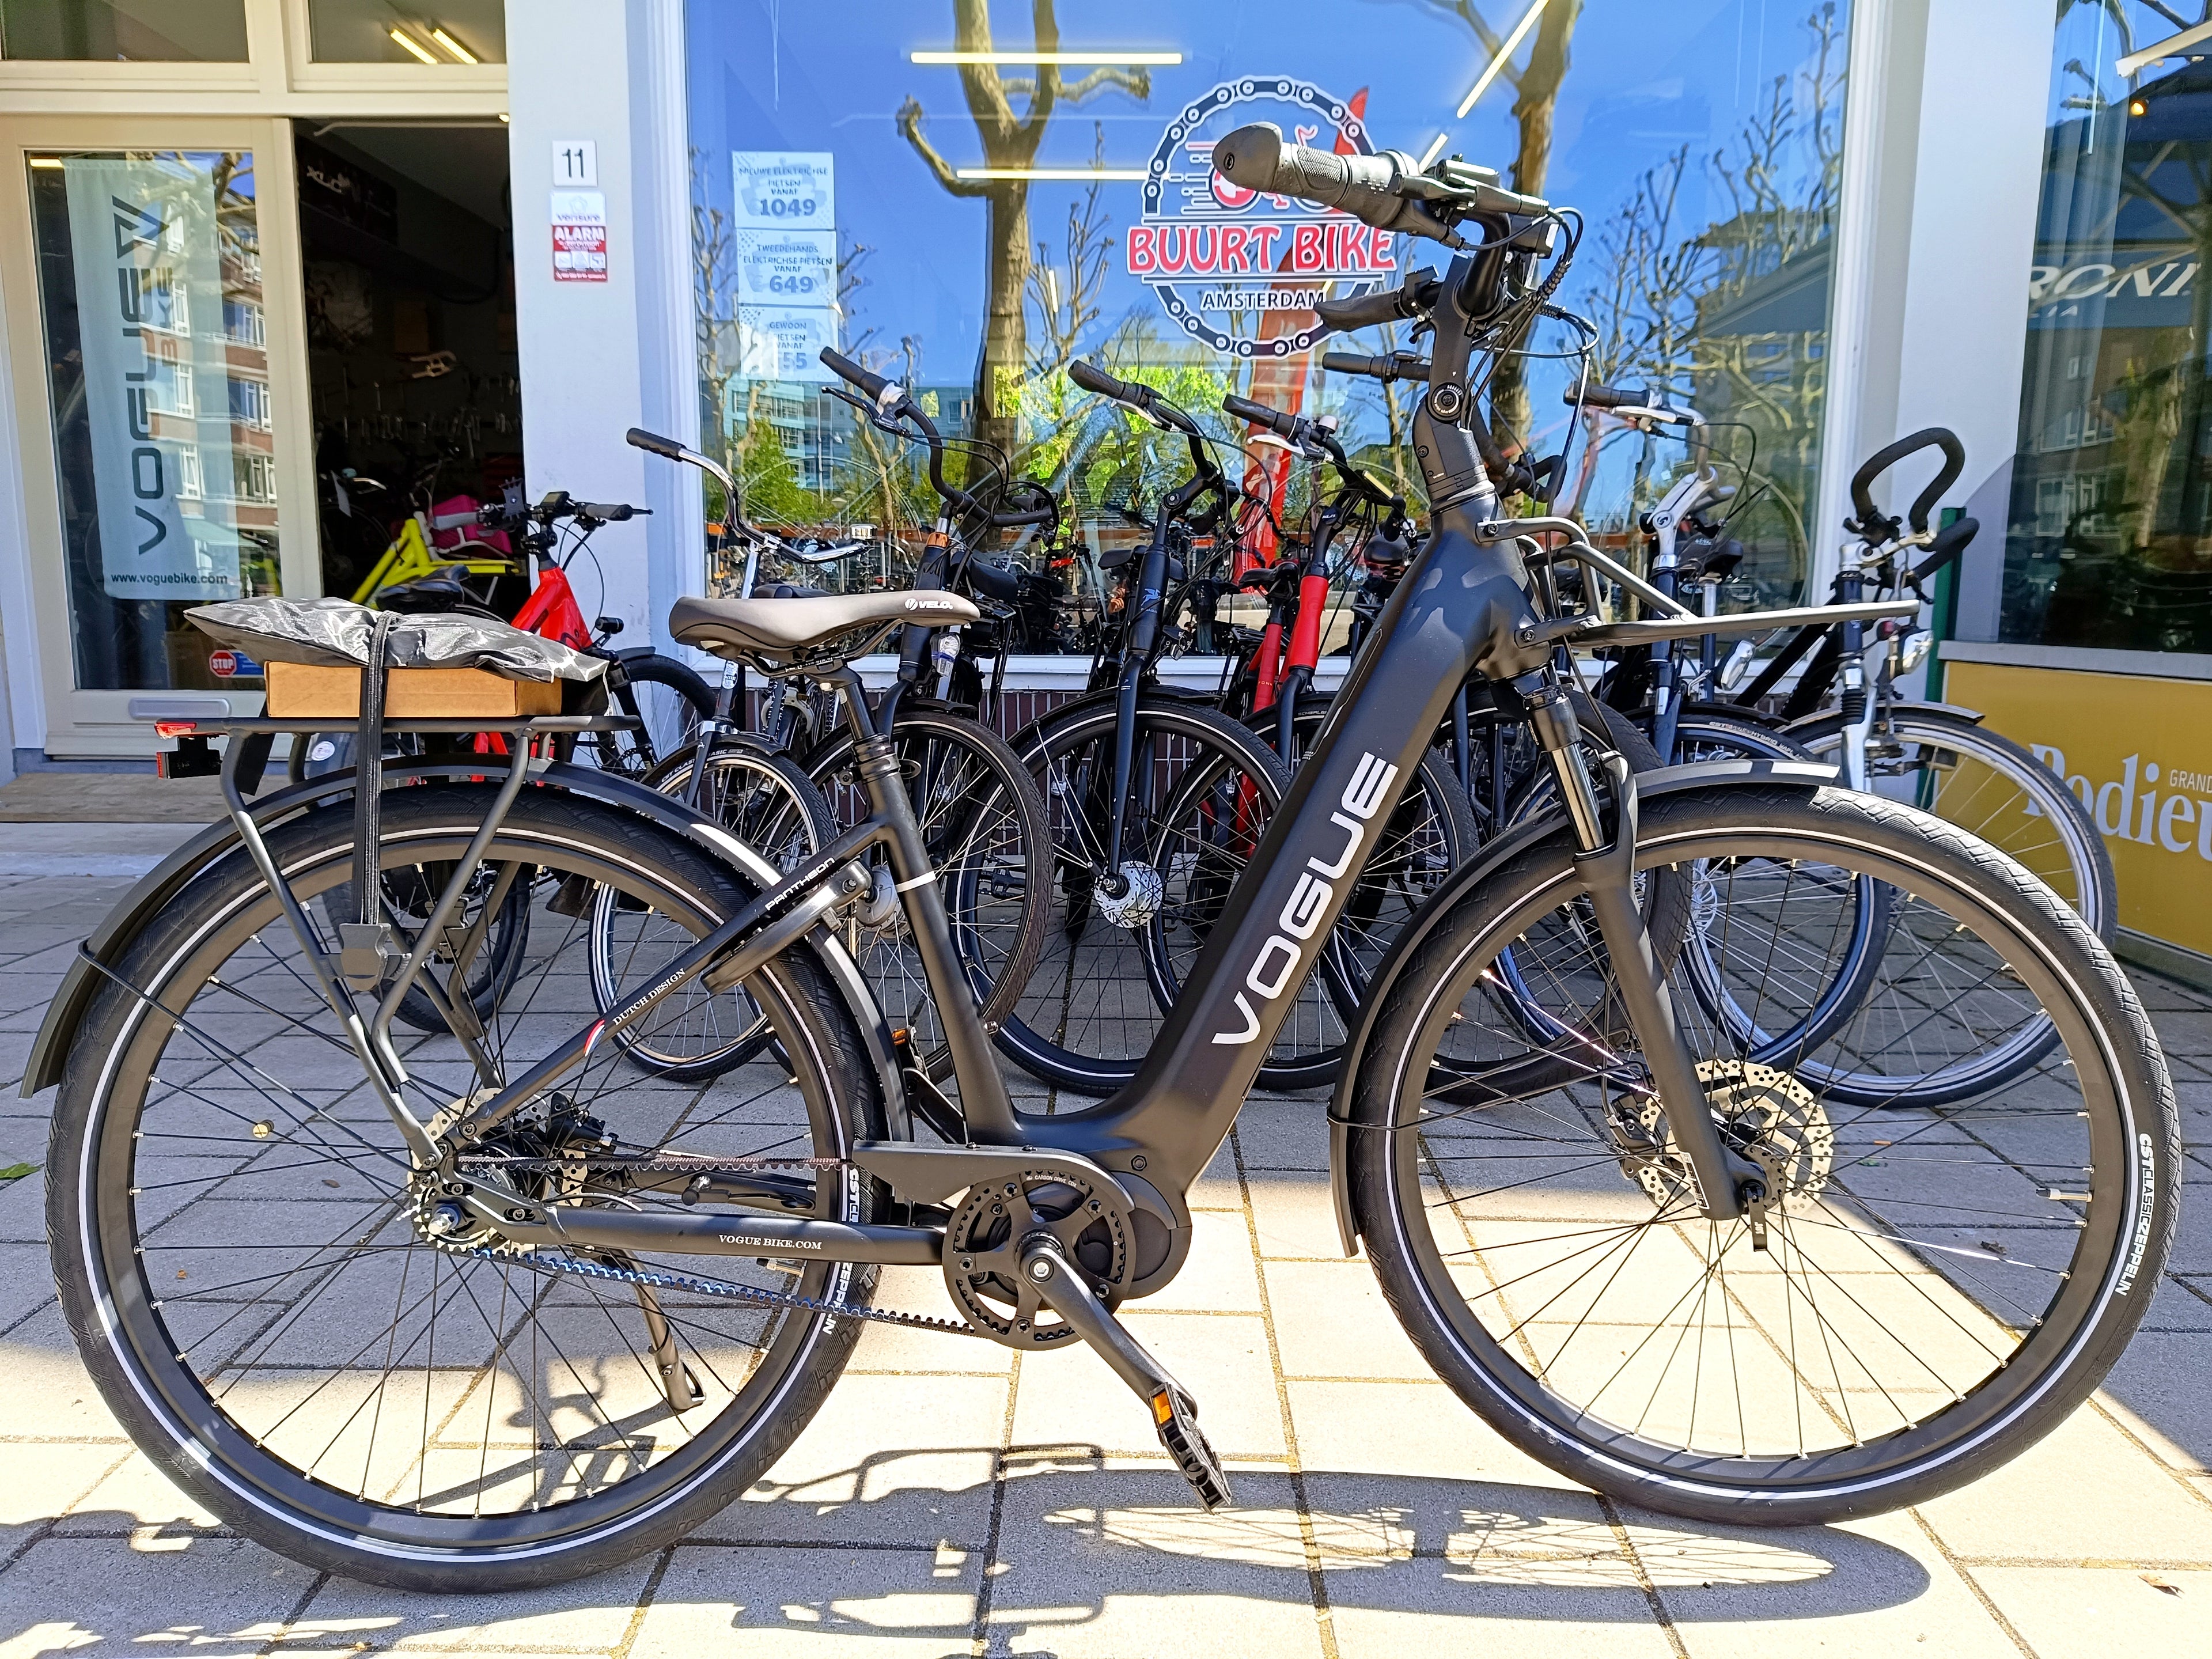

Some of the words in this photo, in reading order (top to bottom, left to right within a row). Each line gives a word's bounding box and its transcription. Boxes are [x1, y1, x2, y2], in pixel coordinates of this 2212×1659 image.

[562, 147, 585, 179] 11
[760, 198, 817, 217] 1049
[554, 226, 605, 241] ALARM
[756, 244, 819, 253] TWEEDEHANDS
[1127, 225, 1281, 274] BUURT
[1293, 224, 1397, 272] BIKE
[800, 257, 832, 266] FIETSEN
[769, 275, 814, 294] 649
[1202, 289, 1326, 311] AMSTERDAM
[769, 321, 807, 329] GEWOON
[118, 267, 167, 556] VOGUE
[1062, 434, 1094, 480] VICTORIA
[111, 573, 228, 586] www.voguebike.com
[918, 600, 951, 609] VELO
[212, 658, 234, 669] STOP
[764, 857, 835, 911] PANTHEON
[1211, 751, 1399, 1044] VOGUE
[612, 995, 650, 1026] DUTCH
[647, 968, 686, 999] DESIGN
[718, 1234, 762, 1246] VOGUE
[762, 1237, 823, 1250] BIKE.COM
